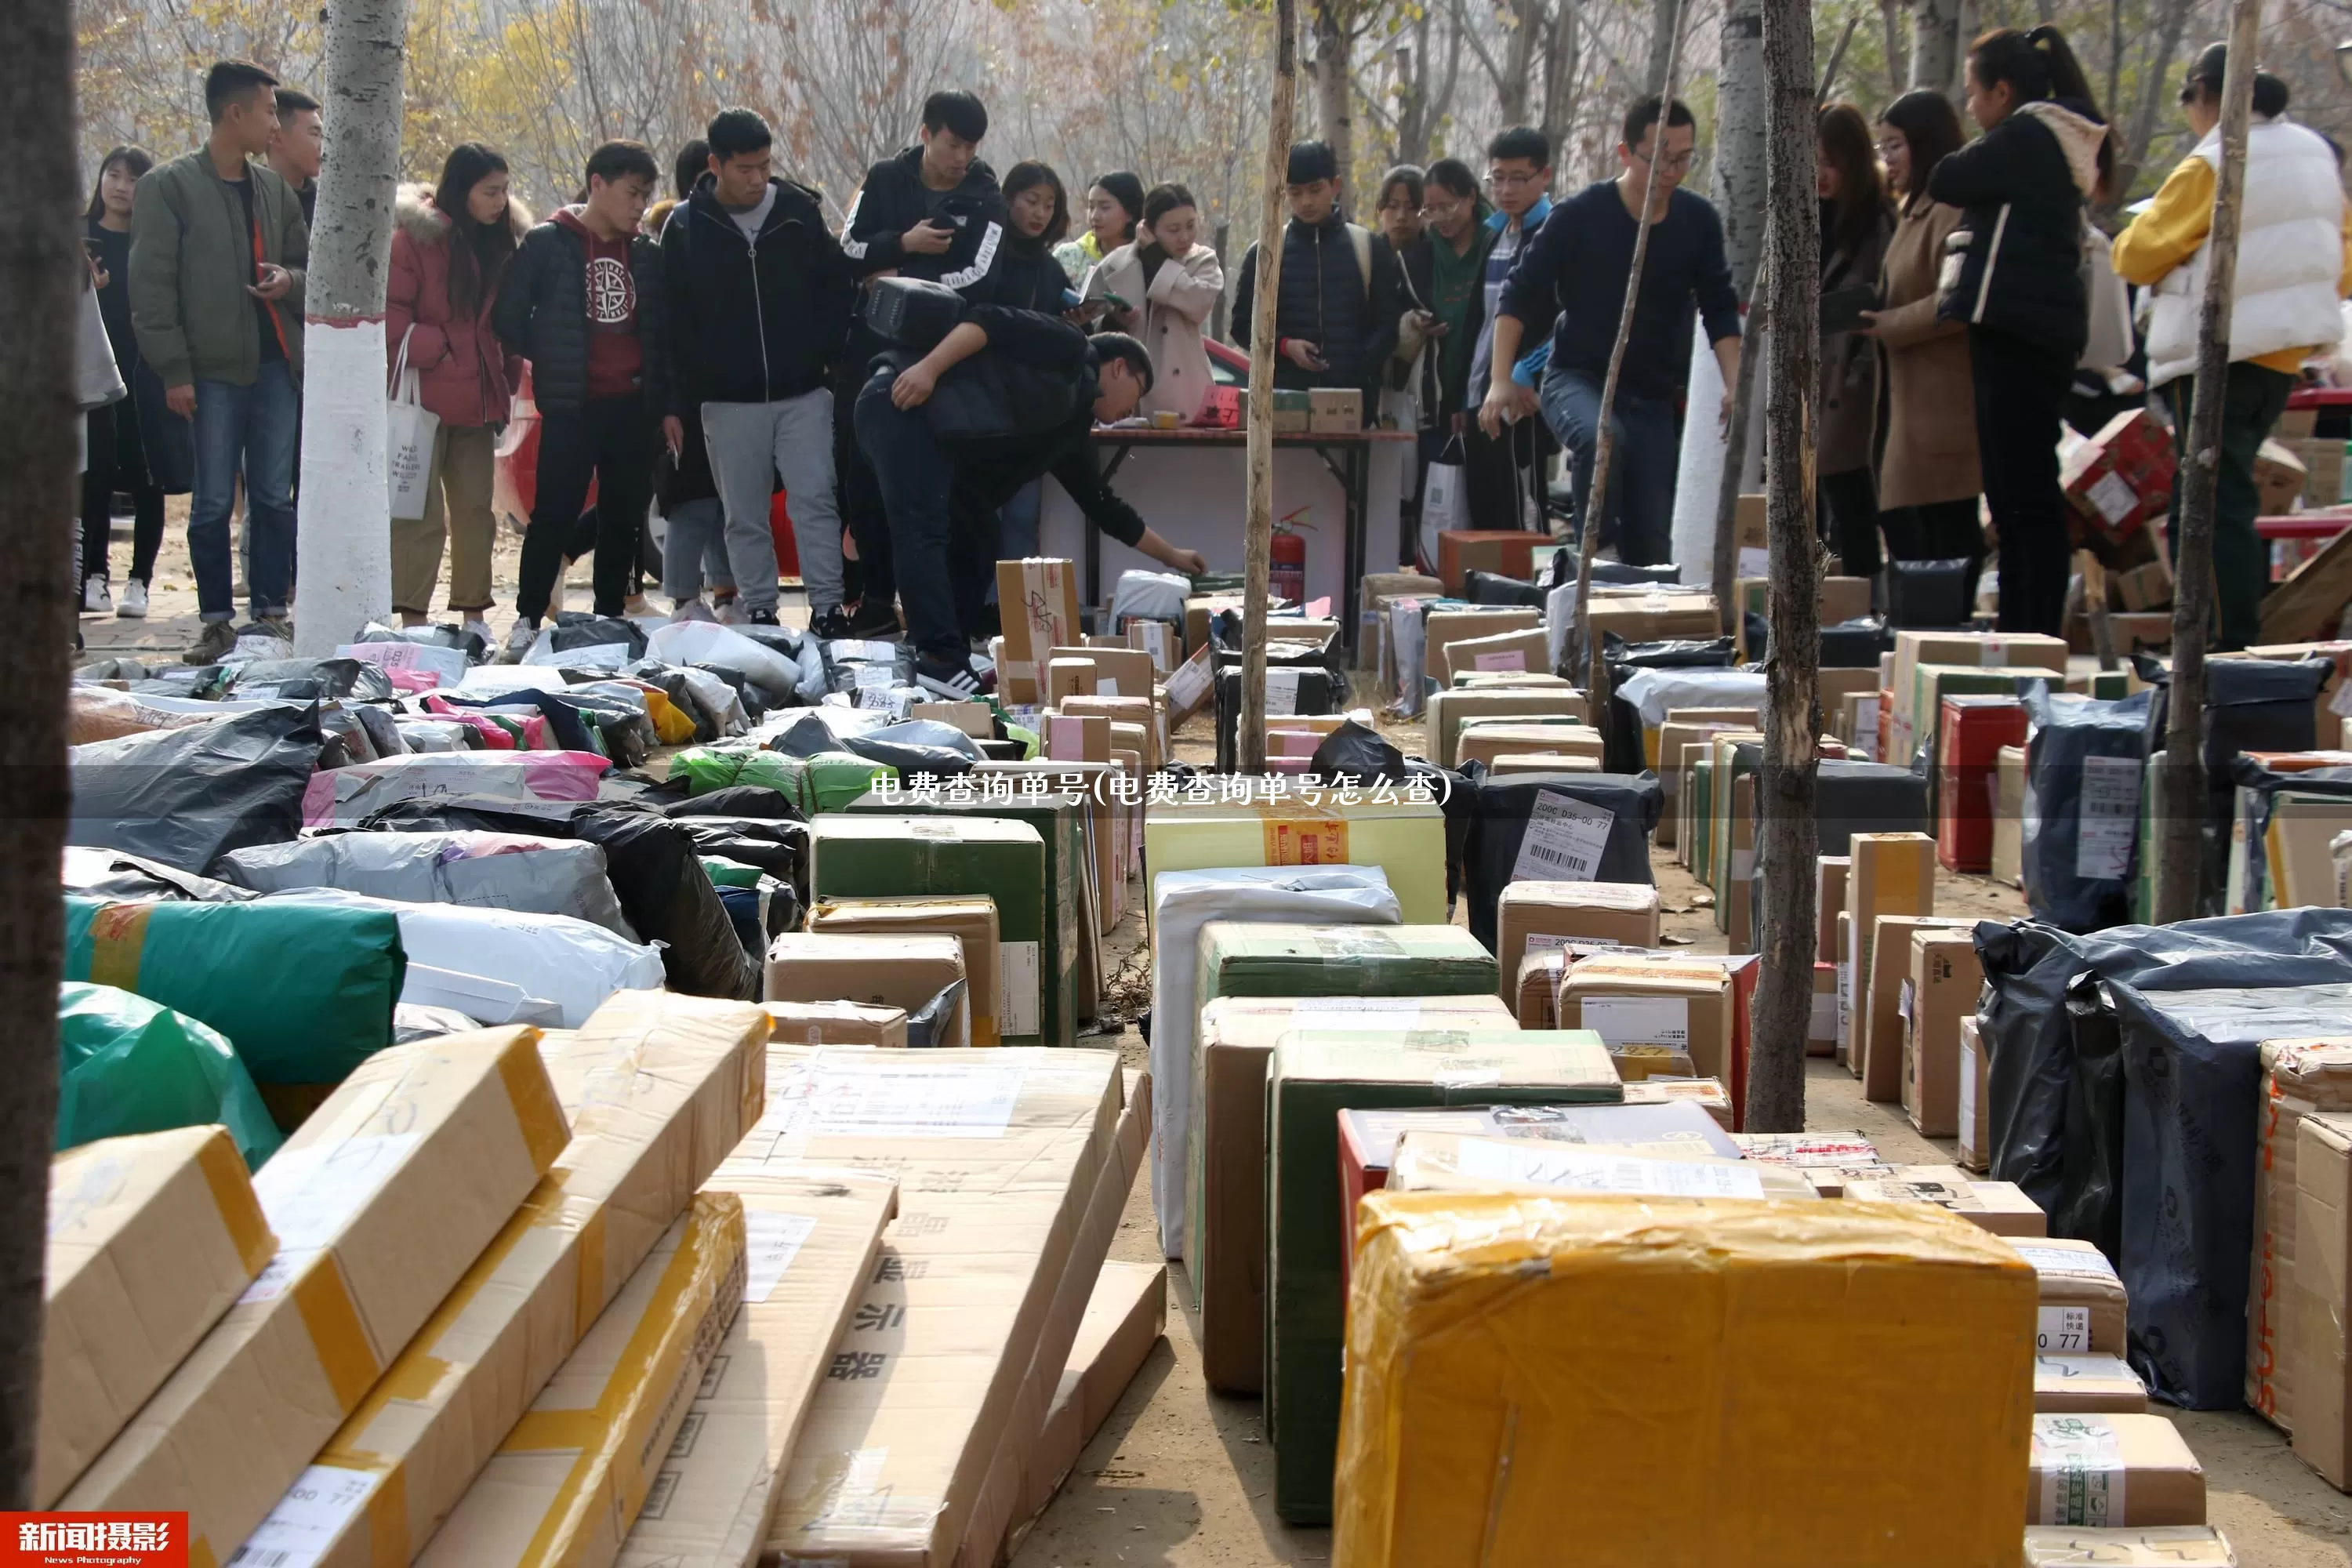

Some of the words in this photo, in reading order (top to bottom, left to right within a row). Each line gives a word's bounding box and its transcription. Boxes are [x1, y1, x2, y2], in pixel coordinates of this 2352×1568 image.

[1596, 821, 1608, 829] 77
[2066, 1312, 2083, 1320] 标准
[2066, 1322, 2084, 1330] 快递
[2060, 1334, 2080, 1348] 77
